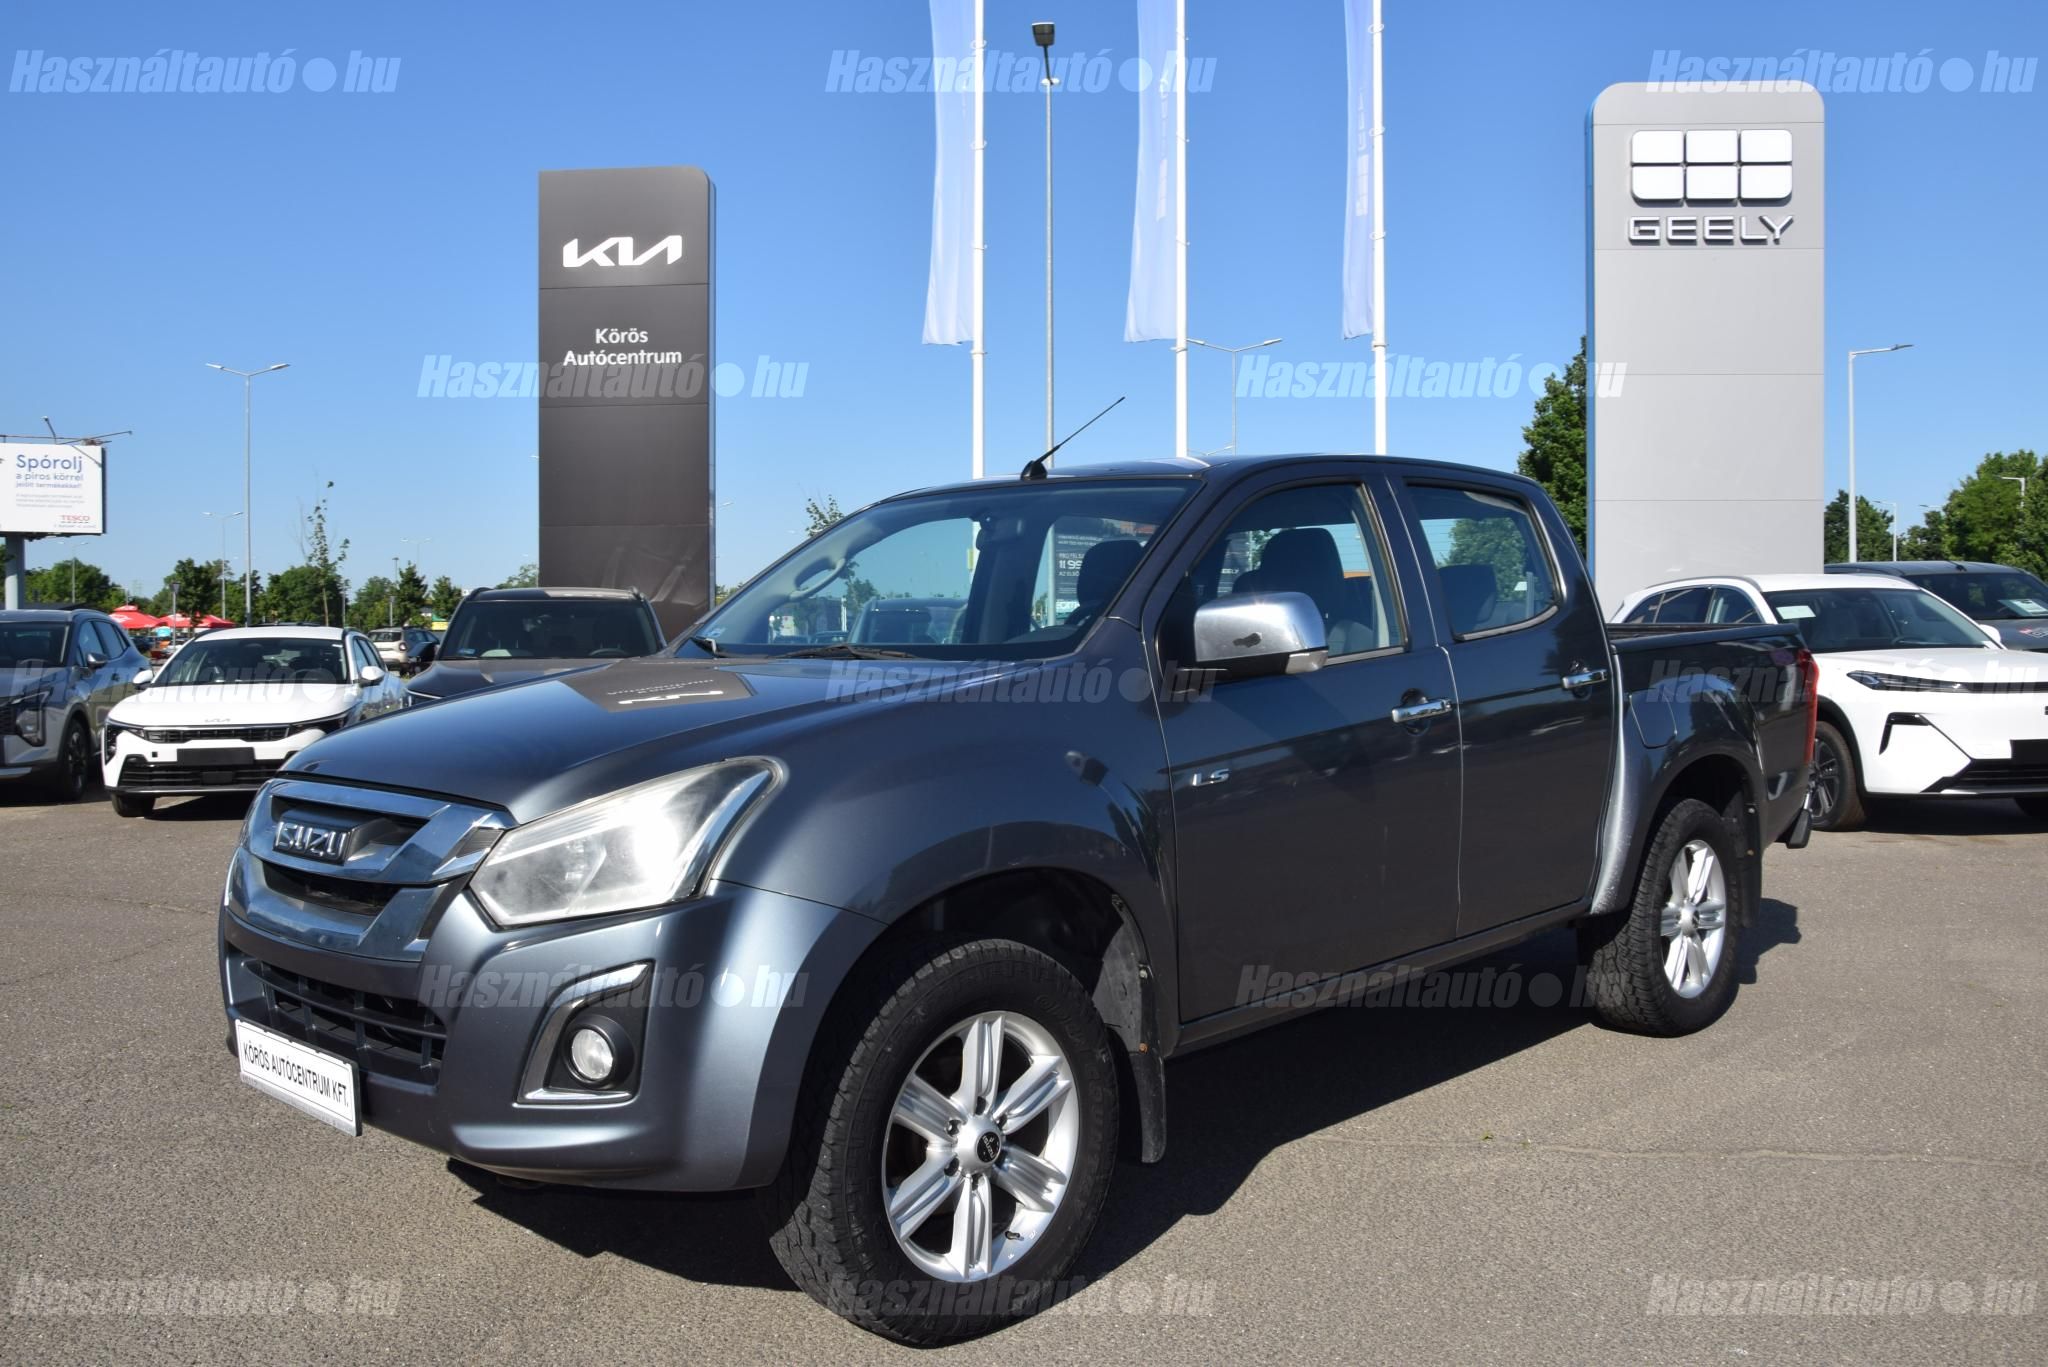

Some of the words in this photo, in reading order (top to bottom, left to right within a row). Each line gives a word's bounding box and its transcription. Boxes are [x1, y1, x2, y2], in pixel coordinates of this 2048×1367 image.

[1629, 216, 1794, 245] GEELY
[563, 235, 682, 267] KIA
[595, 328, 649, 344] Körös
[563, 350, 682, 367] Autócentrum
[16, 454, 83, 473] Spórolj
[25, 472, 51, 481] piros
[61, 514, 91, 522] TESCO
[1192, 768, 1230, 787] LS
[275, 821, 348, 858] ISUZU
[332, 1080, 349, 1107] KFT.
